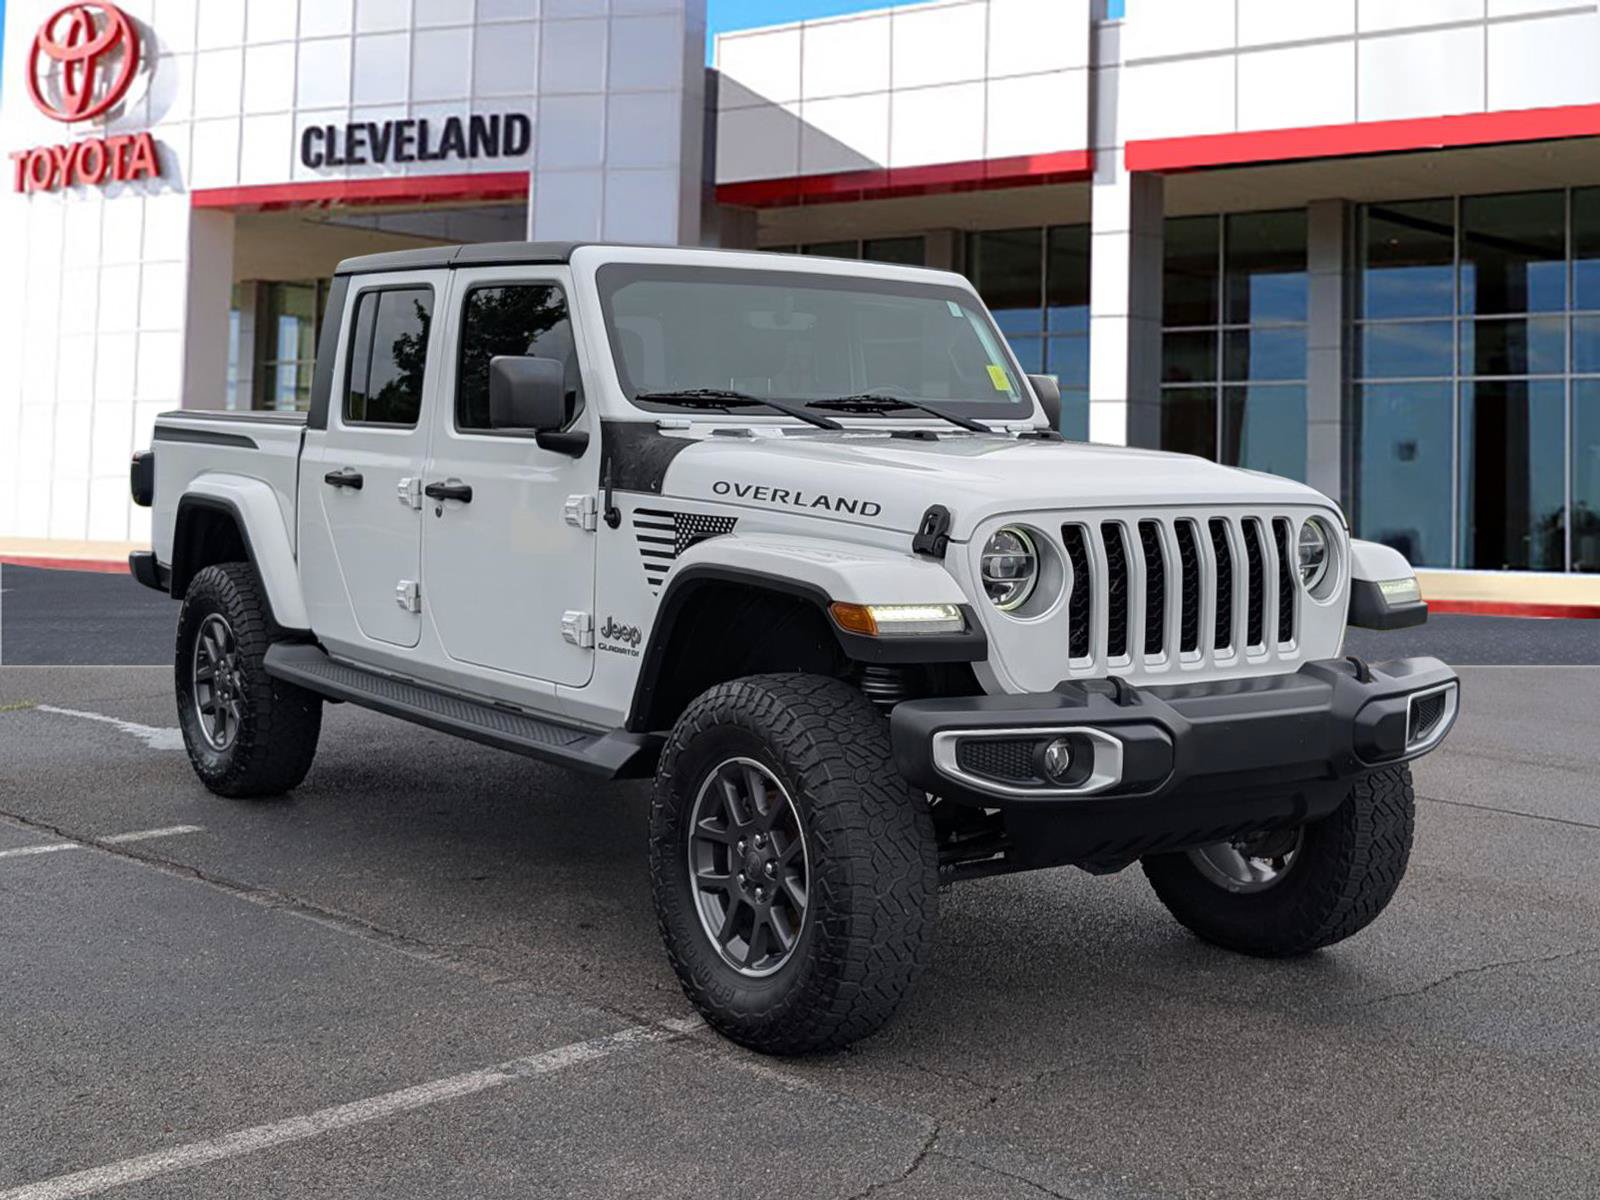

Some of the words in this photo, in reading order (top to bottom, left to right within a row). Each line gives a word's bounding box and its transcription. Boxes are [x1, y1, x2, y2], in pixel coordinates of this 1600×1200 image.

[300, 112, 531, 170] CLEVELAND
[9, 132, 160, 193] TOYOTA
[712, 480, 882, 517] OVERLAND
[598, 642, 640, 657] GLADIATOR
[600, 615, 642, 648] Jeep
